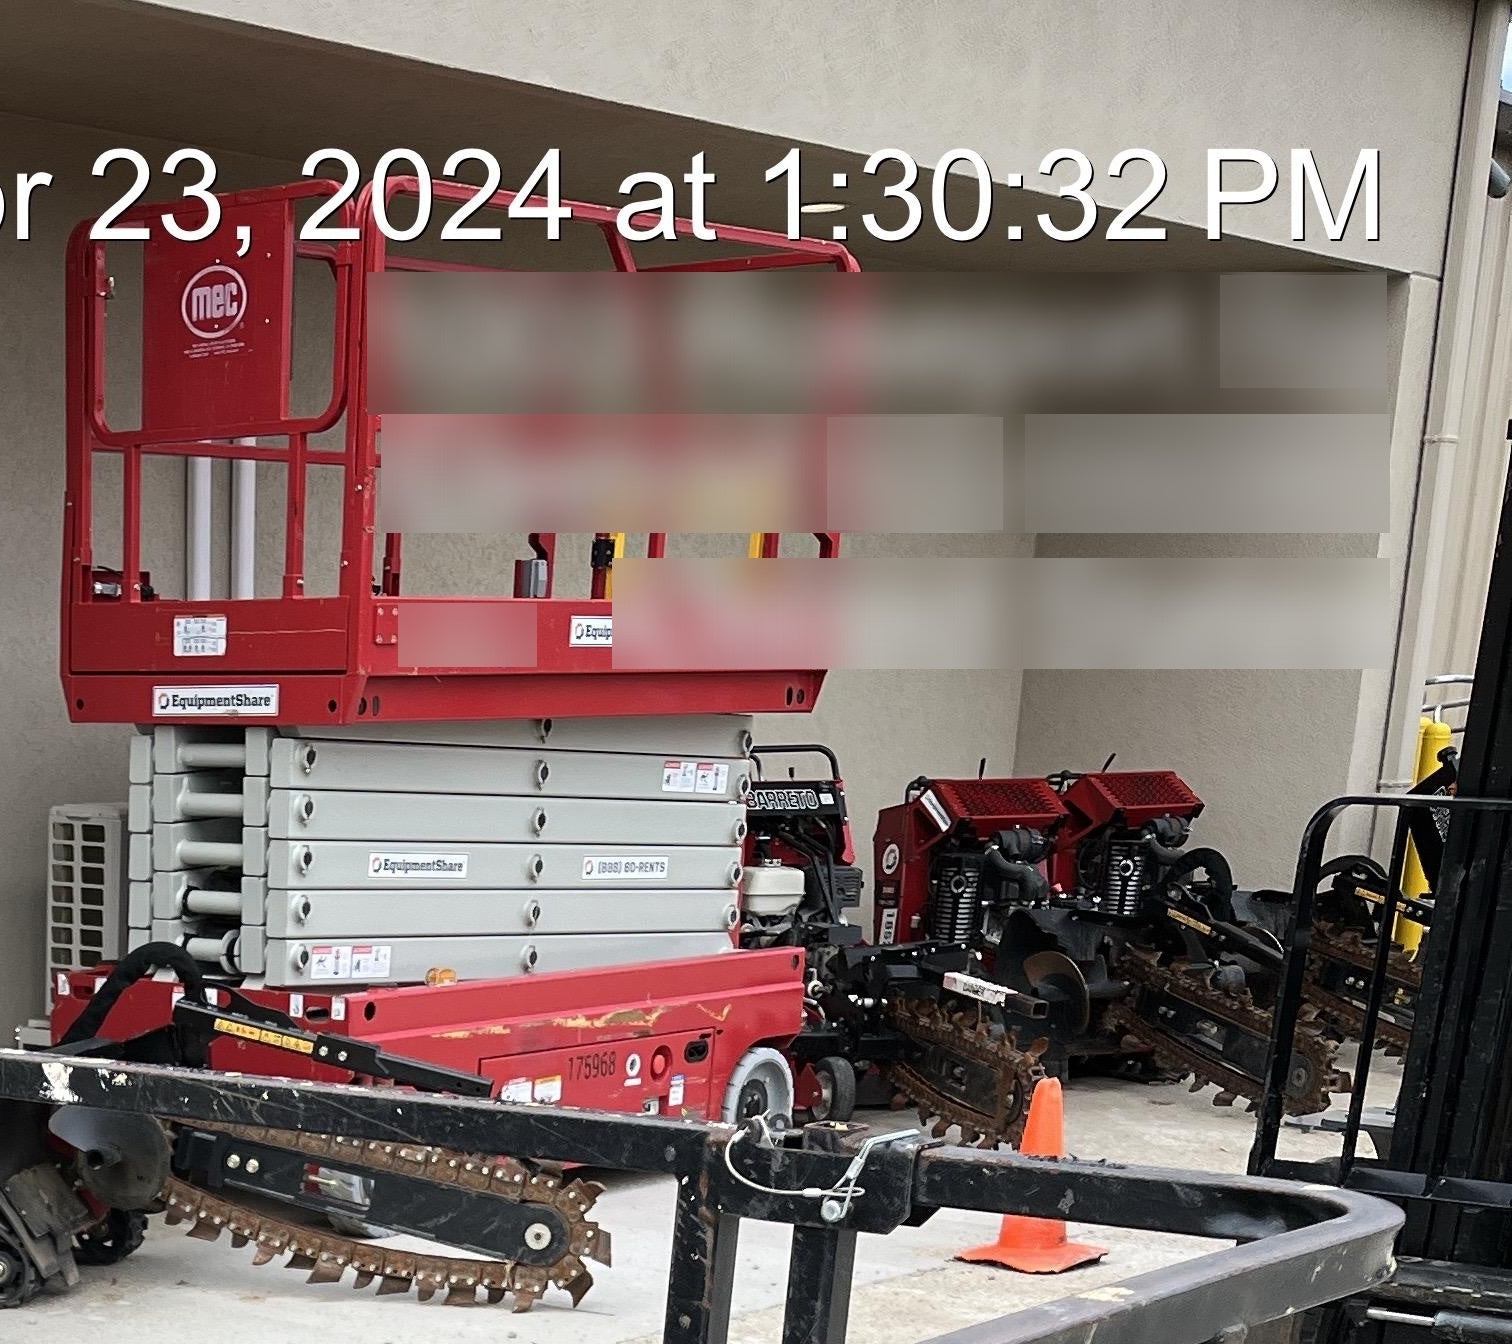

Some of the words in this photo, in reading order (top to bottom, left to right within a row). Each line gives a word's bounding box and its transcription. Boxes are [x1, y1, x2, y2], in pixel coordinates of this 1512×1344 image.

[171, 693, 271, 710] EquipmentShare
[746, 789, 820, 810] BARRETO
[383, 858, 464, 874] EquipmentShare
[568, 1050, 617, 1081] 175968
